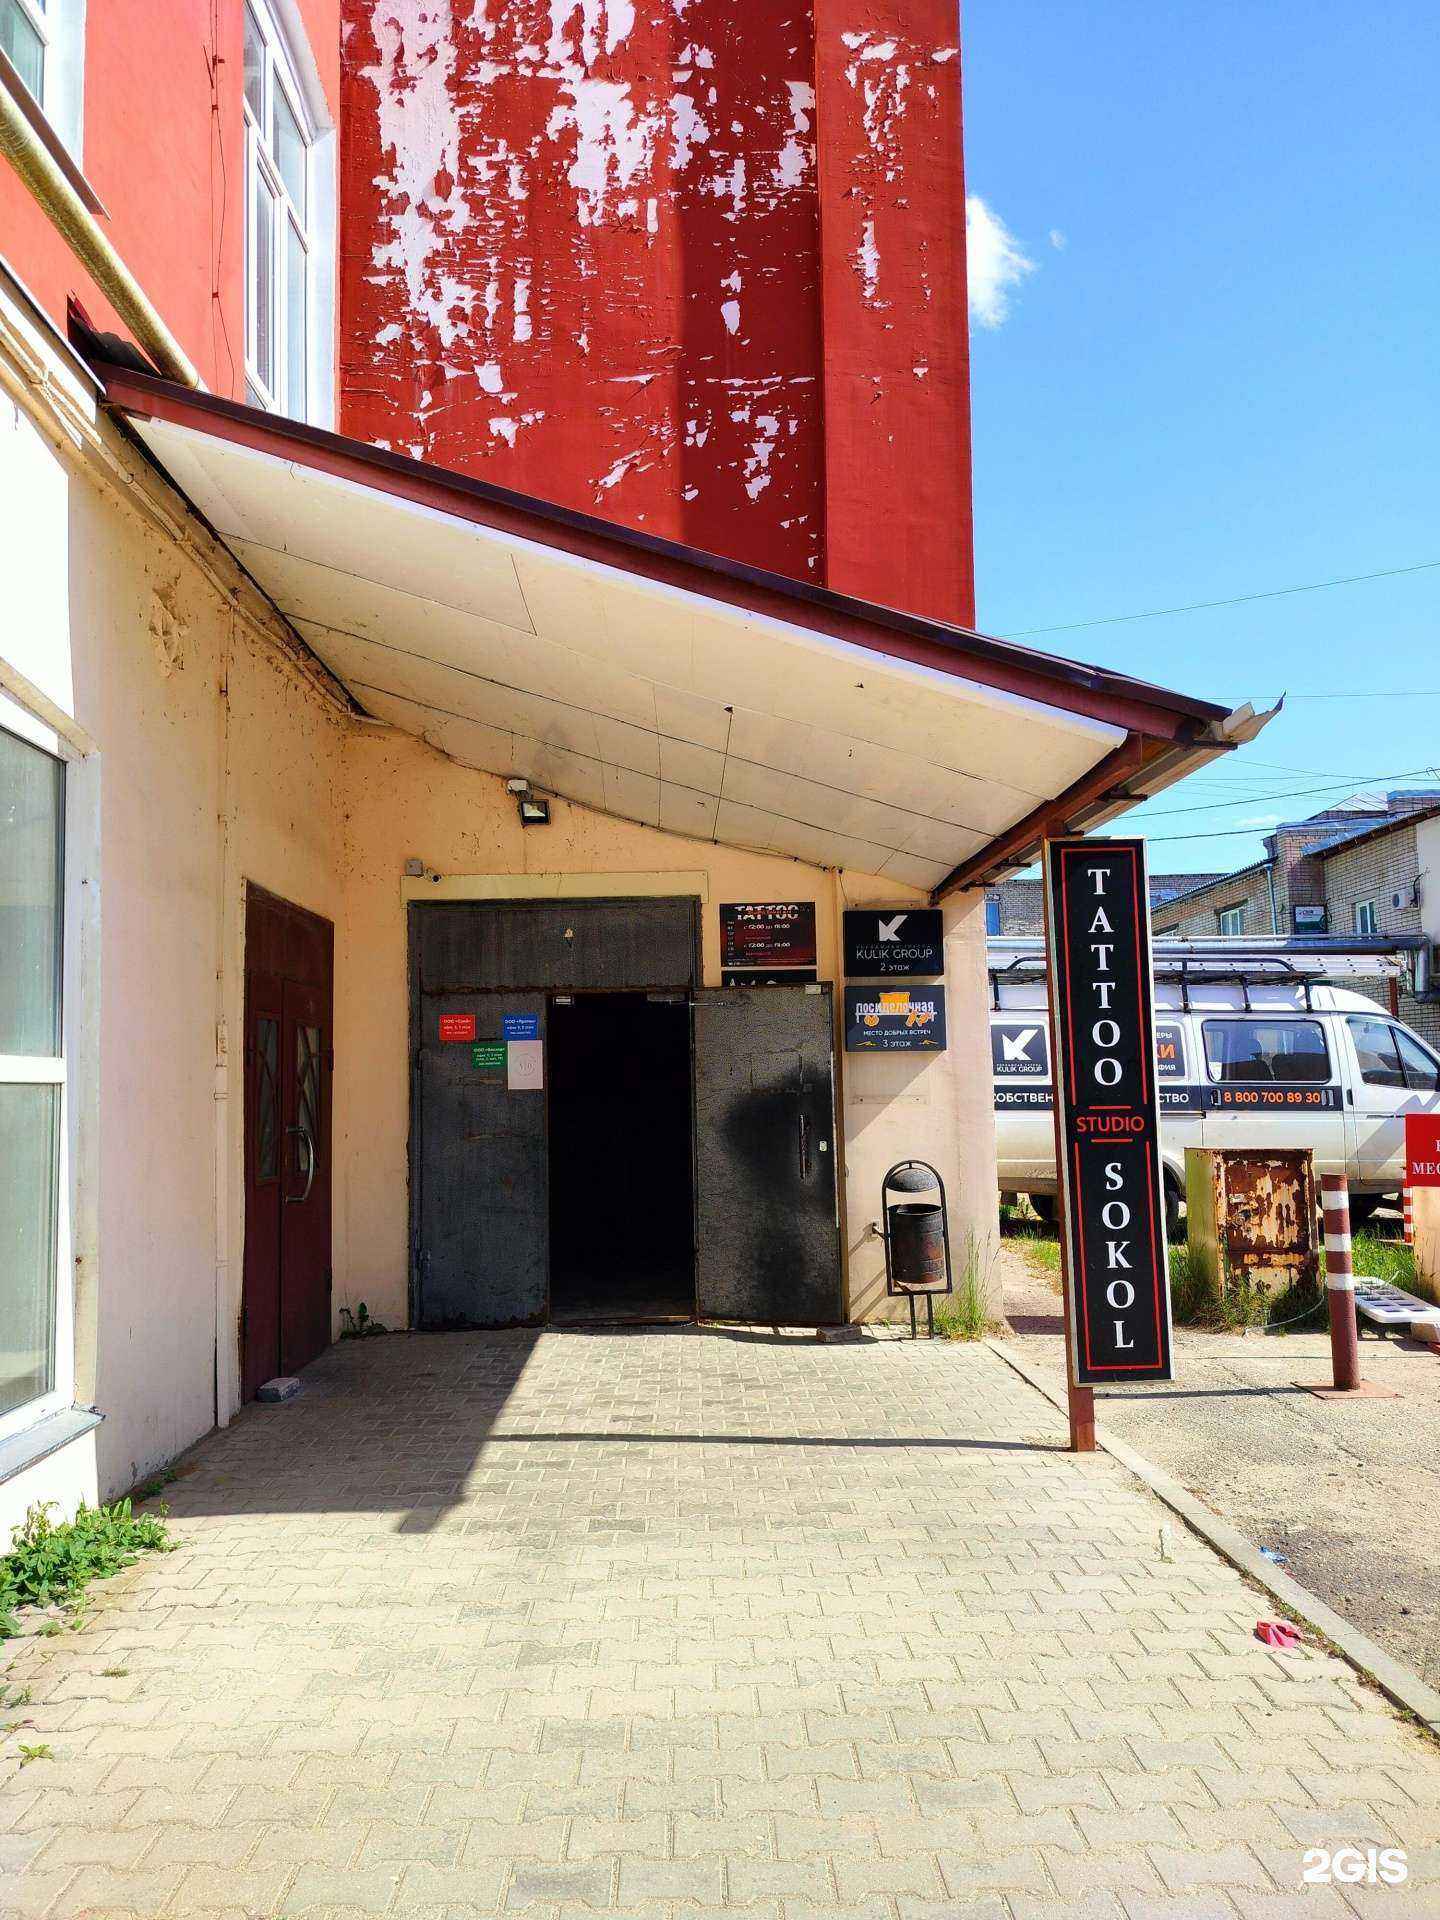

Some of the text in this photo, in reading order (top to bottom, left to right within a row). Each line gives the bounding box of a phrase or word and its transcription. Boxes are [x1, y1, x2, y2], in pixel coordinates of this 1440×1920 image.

[856, 949, 933, 959] KULIK GROUP
[880, 962, 887, 971] 2
[1088, 869, 1123, 1086] TATTOO
[882, 1039, 889, 1047] 3
[1223, 1091, 1321, 1103] 8 800 700 89 30
[1076, 1116, 1145, 1133] STUDIO
[1102, 1162, 1136, 1349] SOKOL
